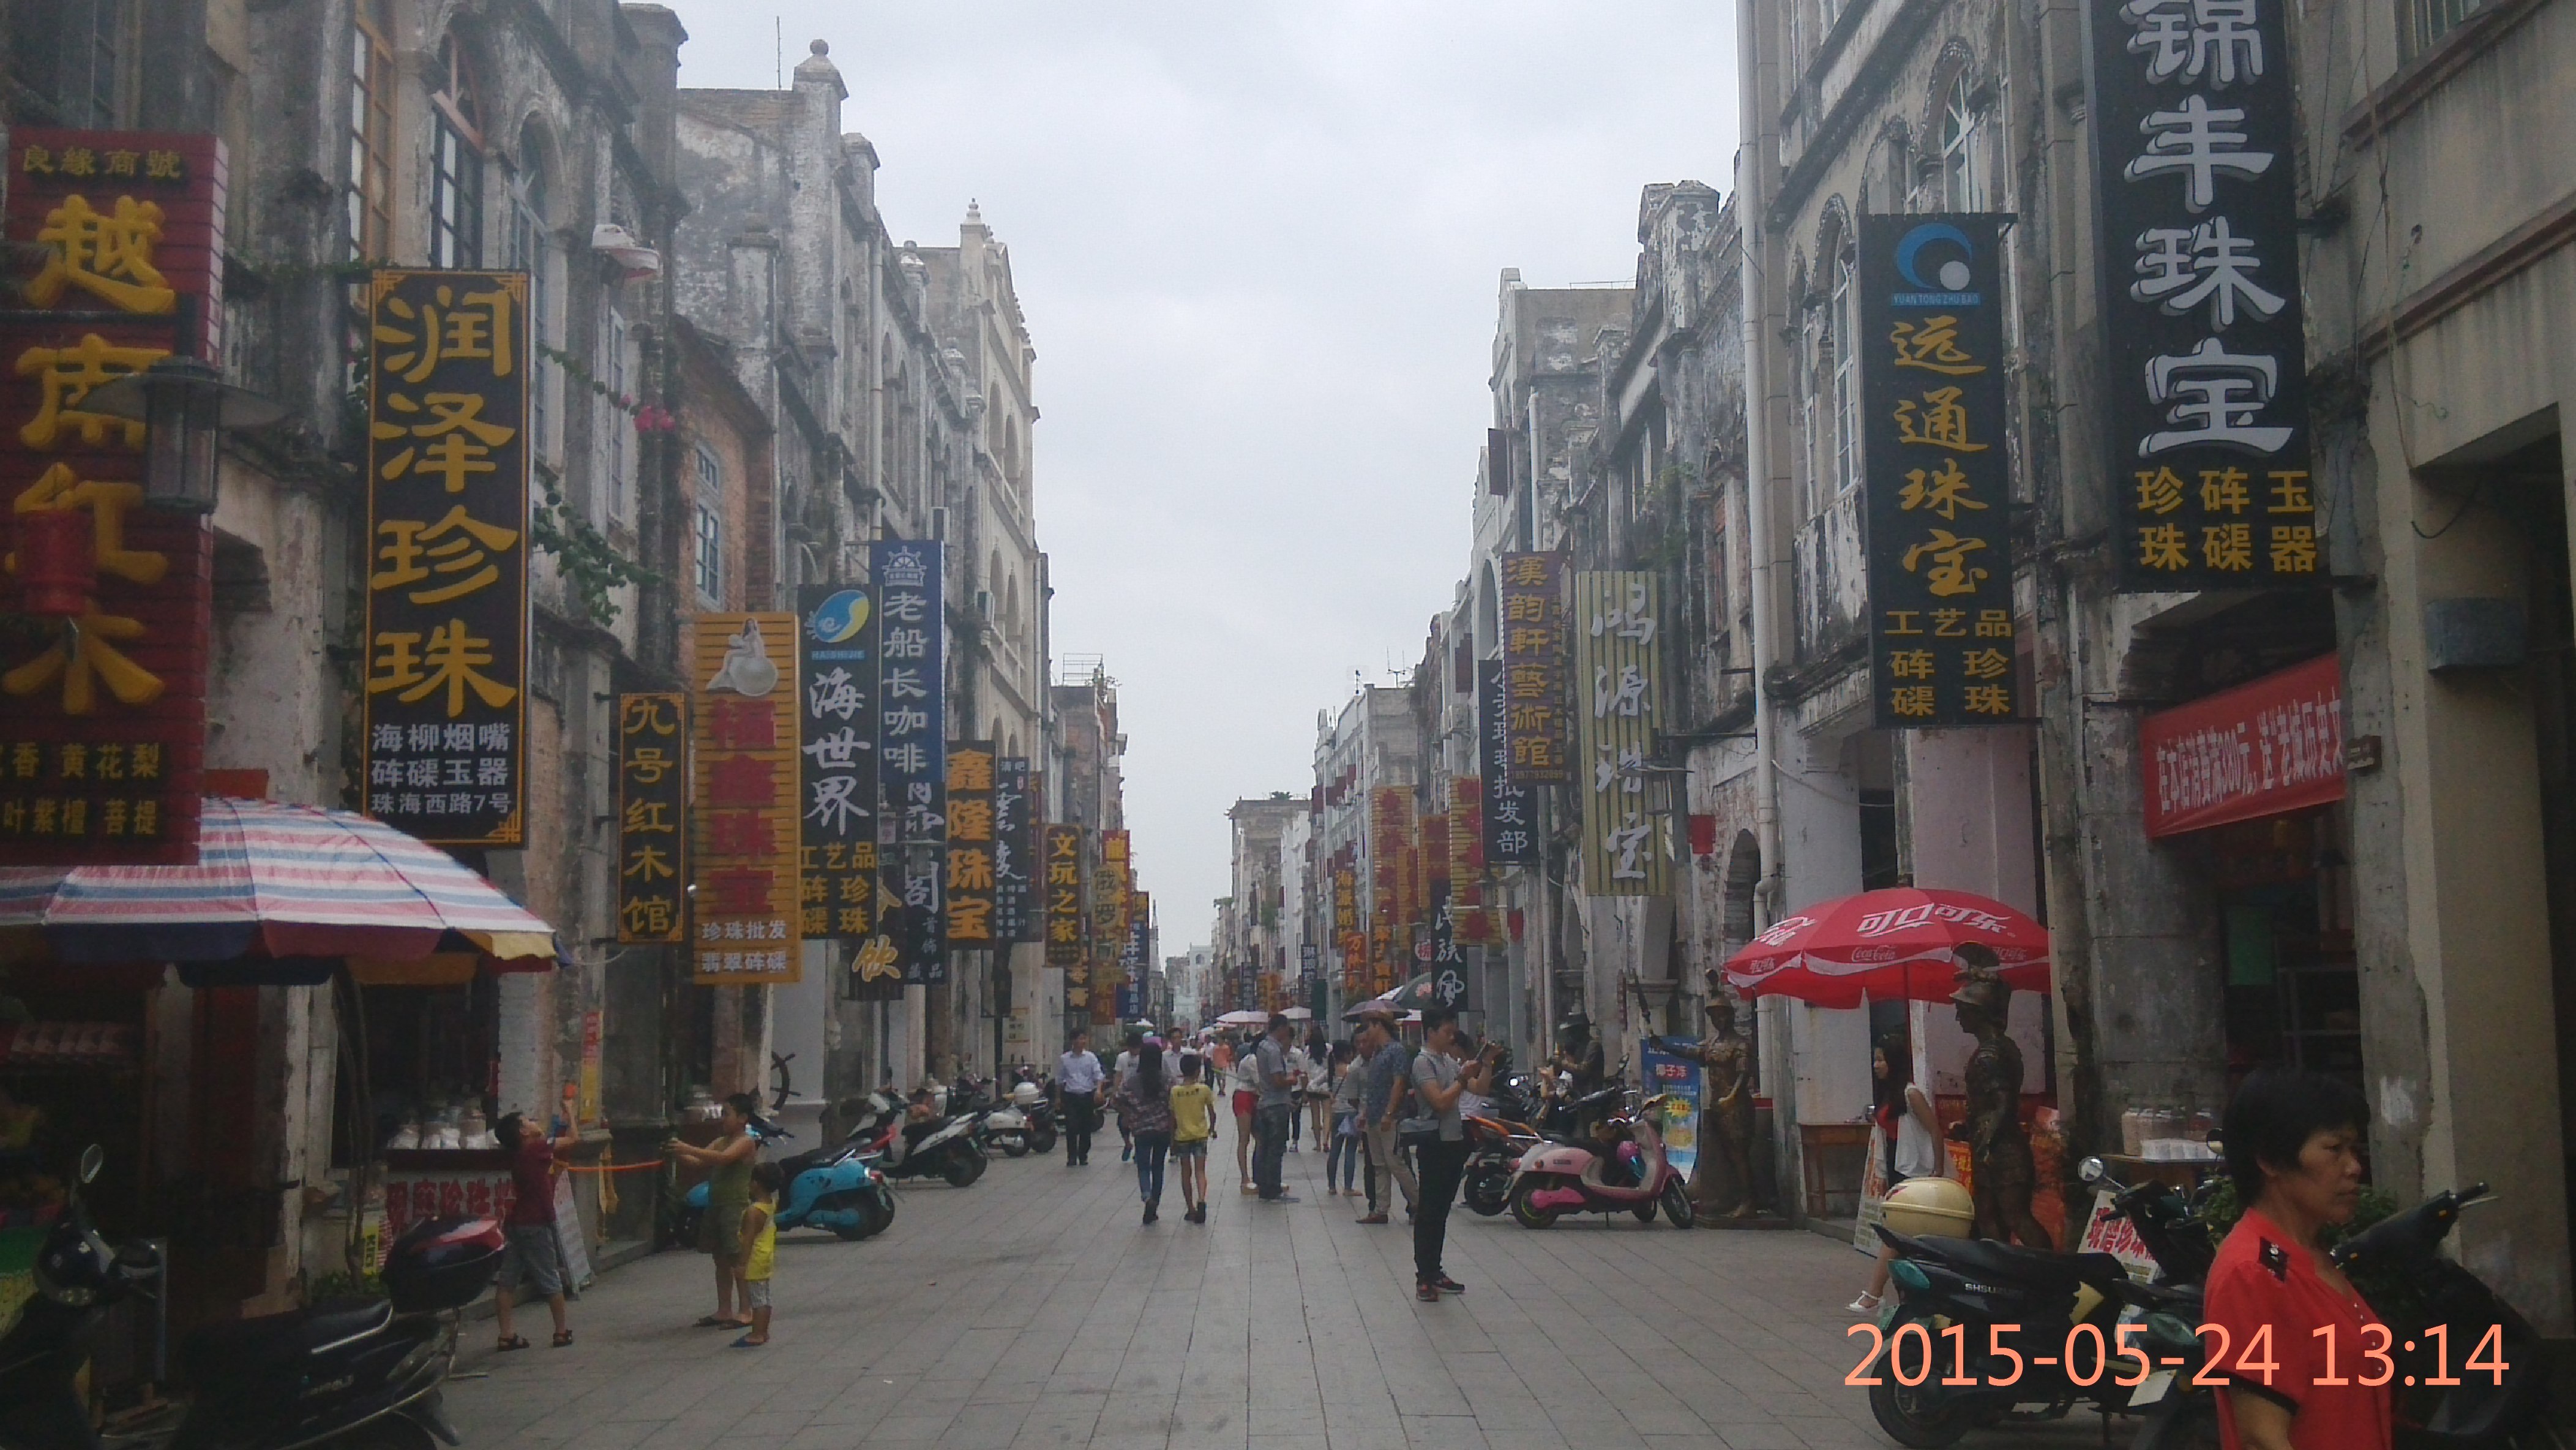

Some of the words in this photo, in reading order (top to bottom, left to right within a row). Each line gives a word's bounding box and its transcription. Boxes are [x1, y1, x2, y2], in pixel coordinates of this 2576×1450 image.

[22, 145, 181, 179] 良緣商號
[1893, 293, 1917, 304] YUAN
[1919, 293, 1941, 304] TONG
[1943, 293, 1960, 304] ZHU
[1889, 315, 1990, 598] 远通珠宝
[372, 284, 519, 717] 润泽珍珠
[1885, 609, 2013, 637] 工艺品
[882, 591, 928, 773] 老船长咖啡
[372, 724, 512, 753] 海柳烟嘴
[801, 666, 871, 835] 海世界
[0, 741, 40, 779] 香
[60, 741, 160, 779] 黄花梨
[372, 759, 511, 788] 砗磲玉器
[372, 792, 512, 815] 珠海西路7号
[622, 700, 675, 934] 九号红木馆
[801, 841, 877, 870] 工艺品
[946, 748, 993, 939] 鑫隆珠宝
[1048, 832, 1078, 943] 文玩之家
[702, 920, 787, 941] 珍珠批发
[1856, 902, 2012, 939] 可口可乐
[702, 951, 787, 972] 翡翠砗磲
